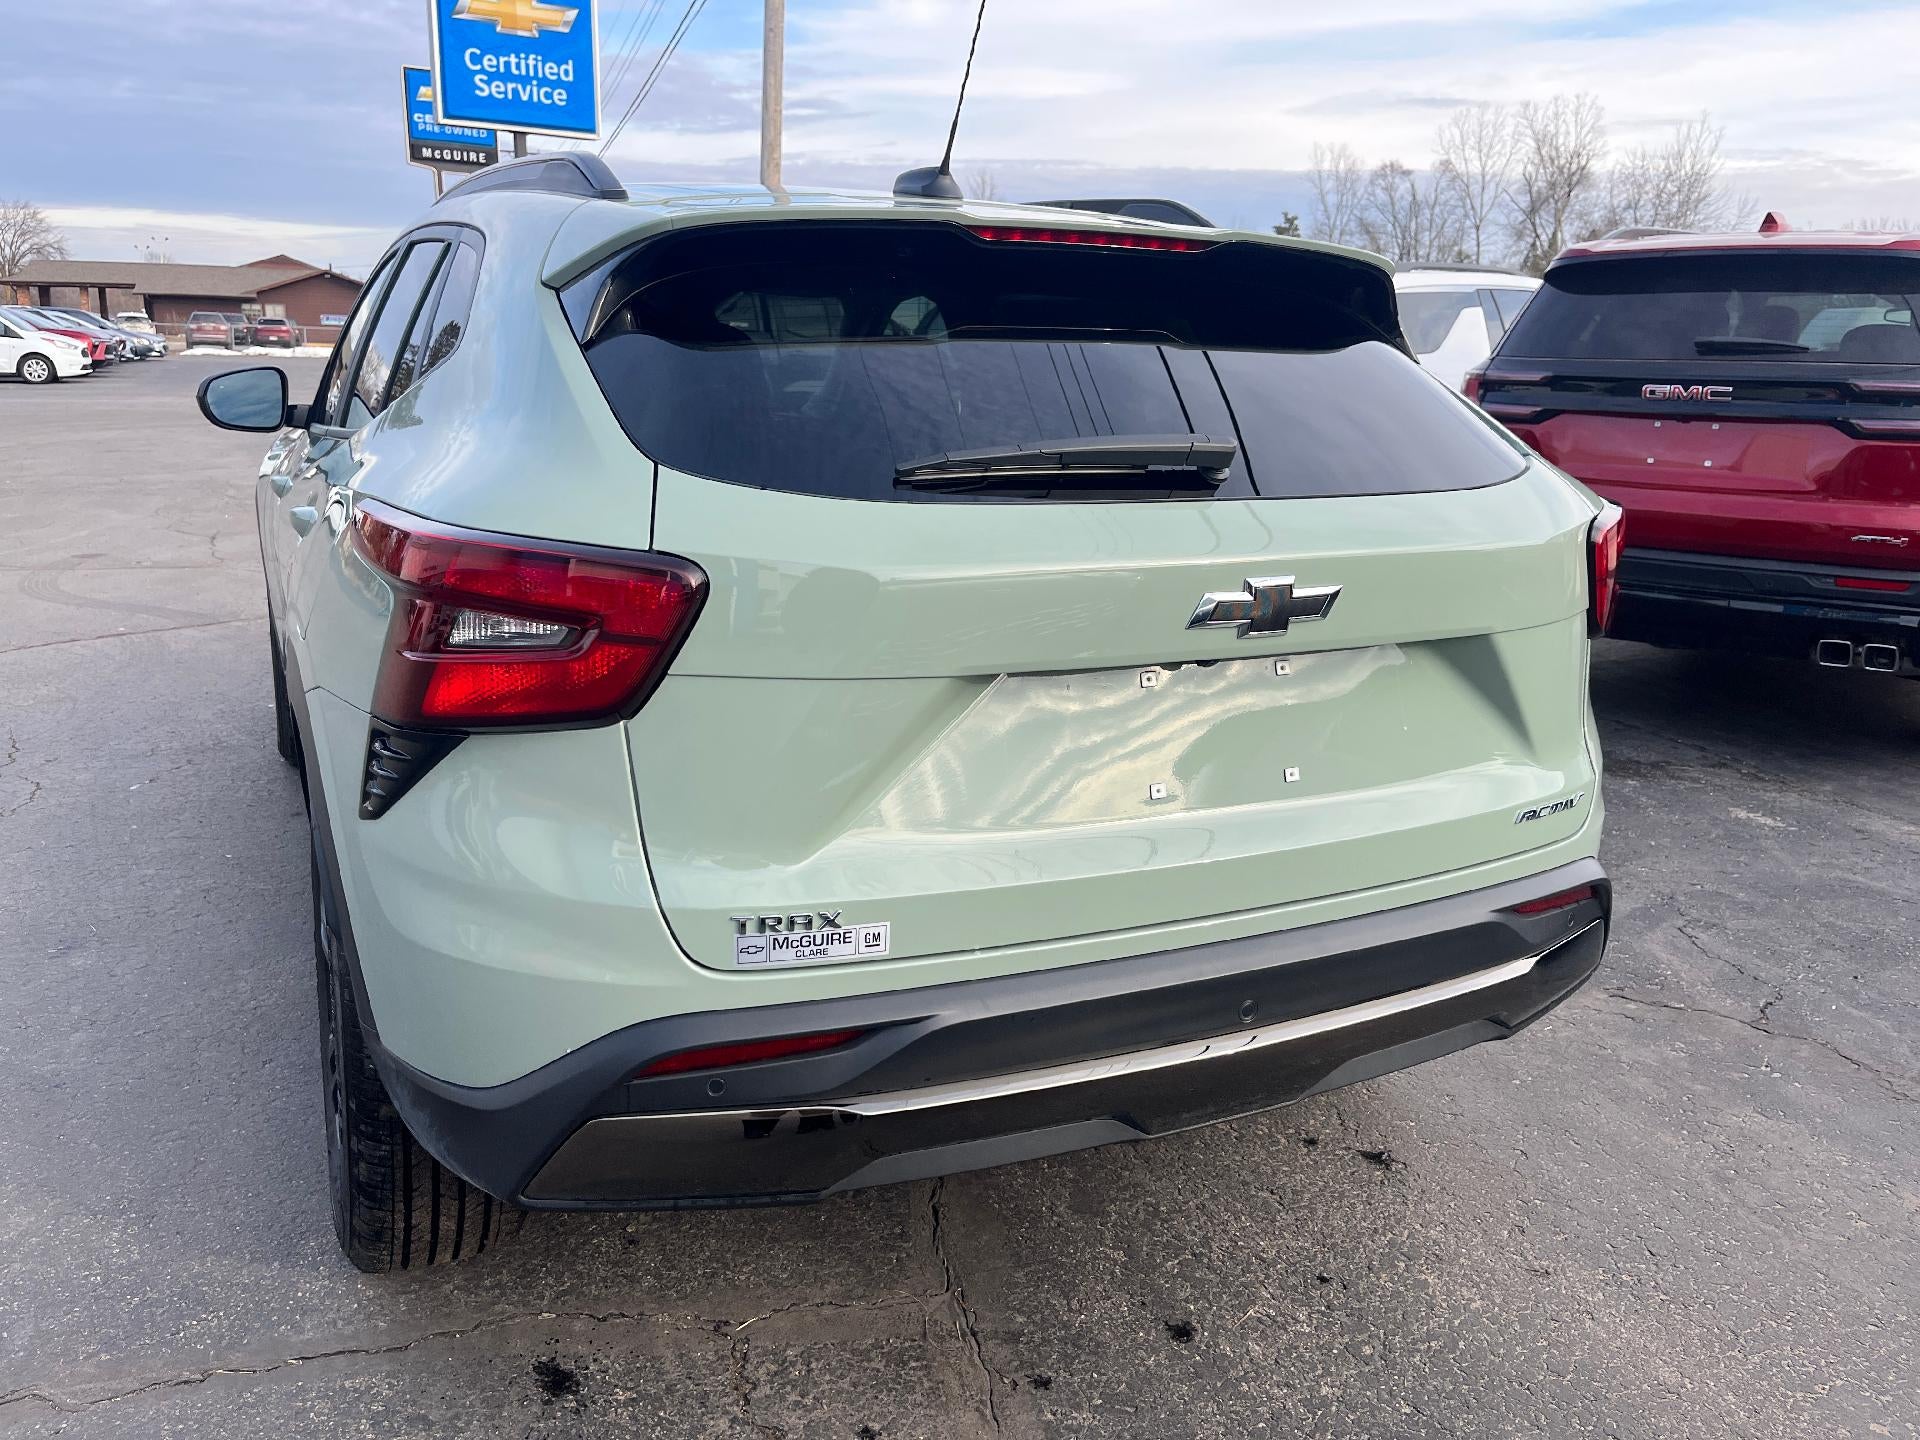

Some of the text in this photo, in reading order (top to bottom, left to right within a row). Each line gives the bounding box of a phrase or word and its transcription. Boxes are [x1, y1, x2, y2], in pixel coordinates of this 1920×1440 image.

[464, 48, 574, 82] Certified
[474, 74, 568, 106] Service
[418, 123, 488, 138] PRE-OWNED
[421, 147, 487, 163] McGUIRE
[1641, 384, 1733, 401] GMC
[730, 909, 843, 935] TRAX
[772, 931, 881, 951] McGUIRE GM
[795, 948, 829, 958] CLARE
